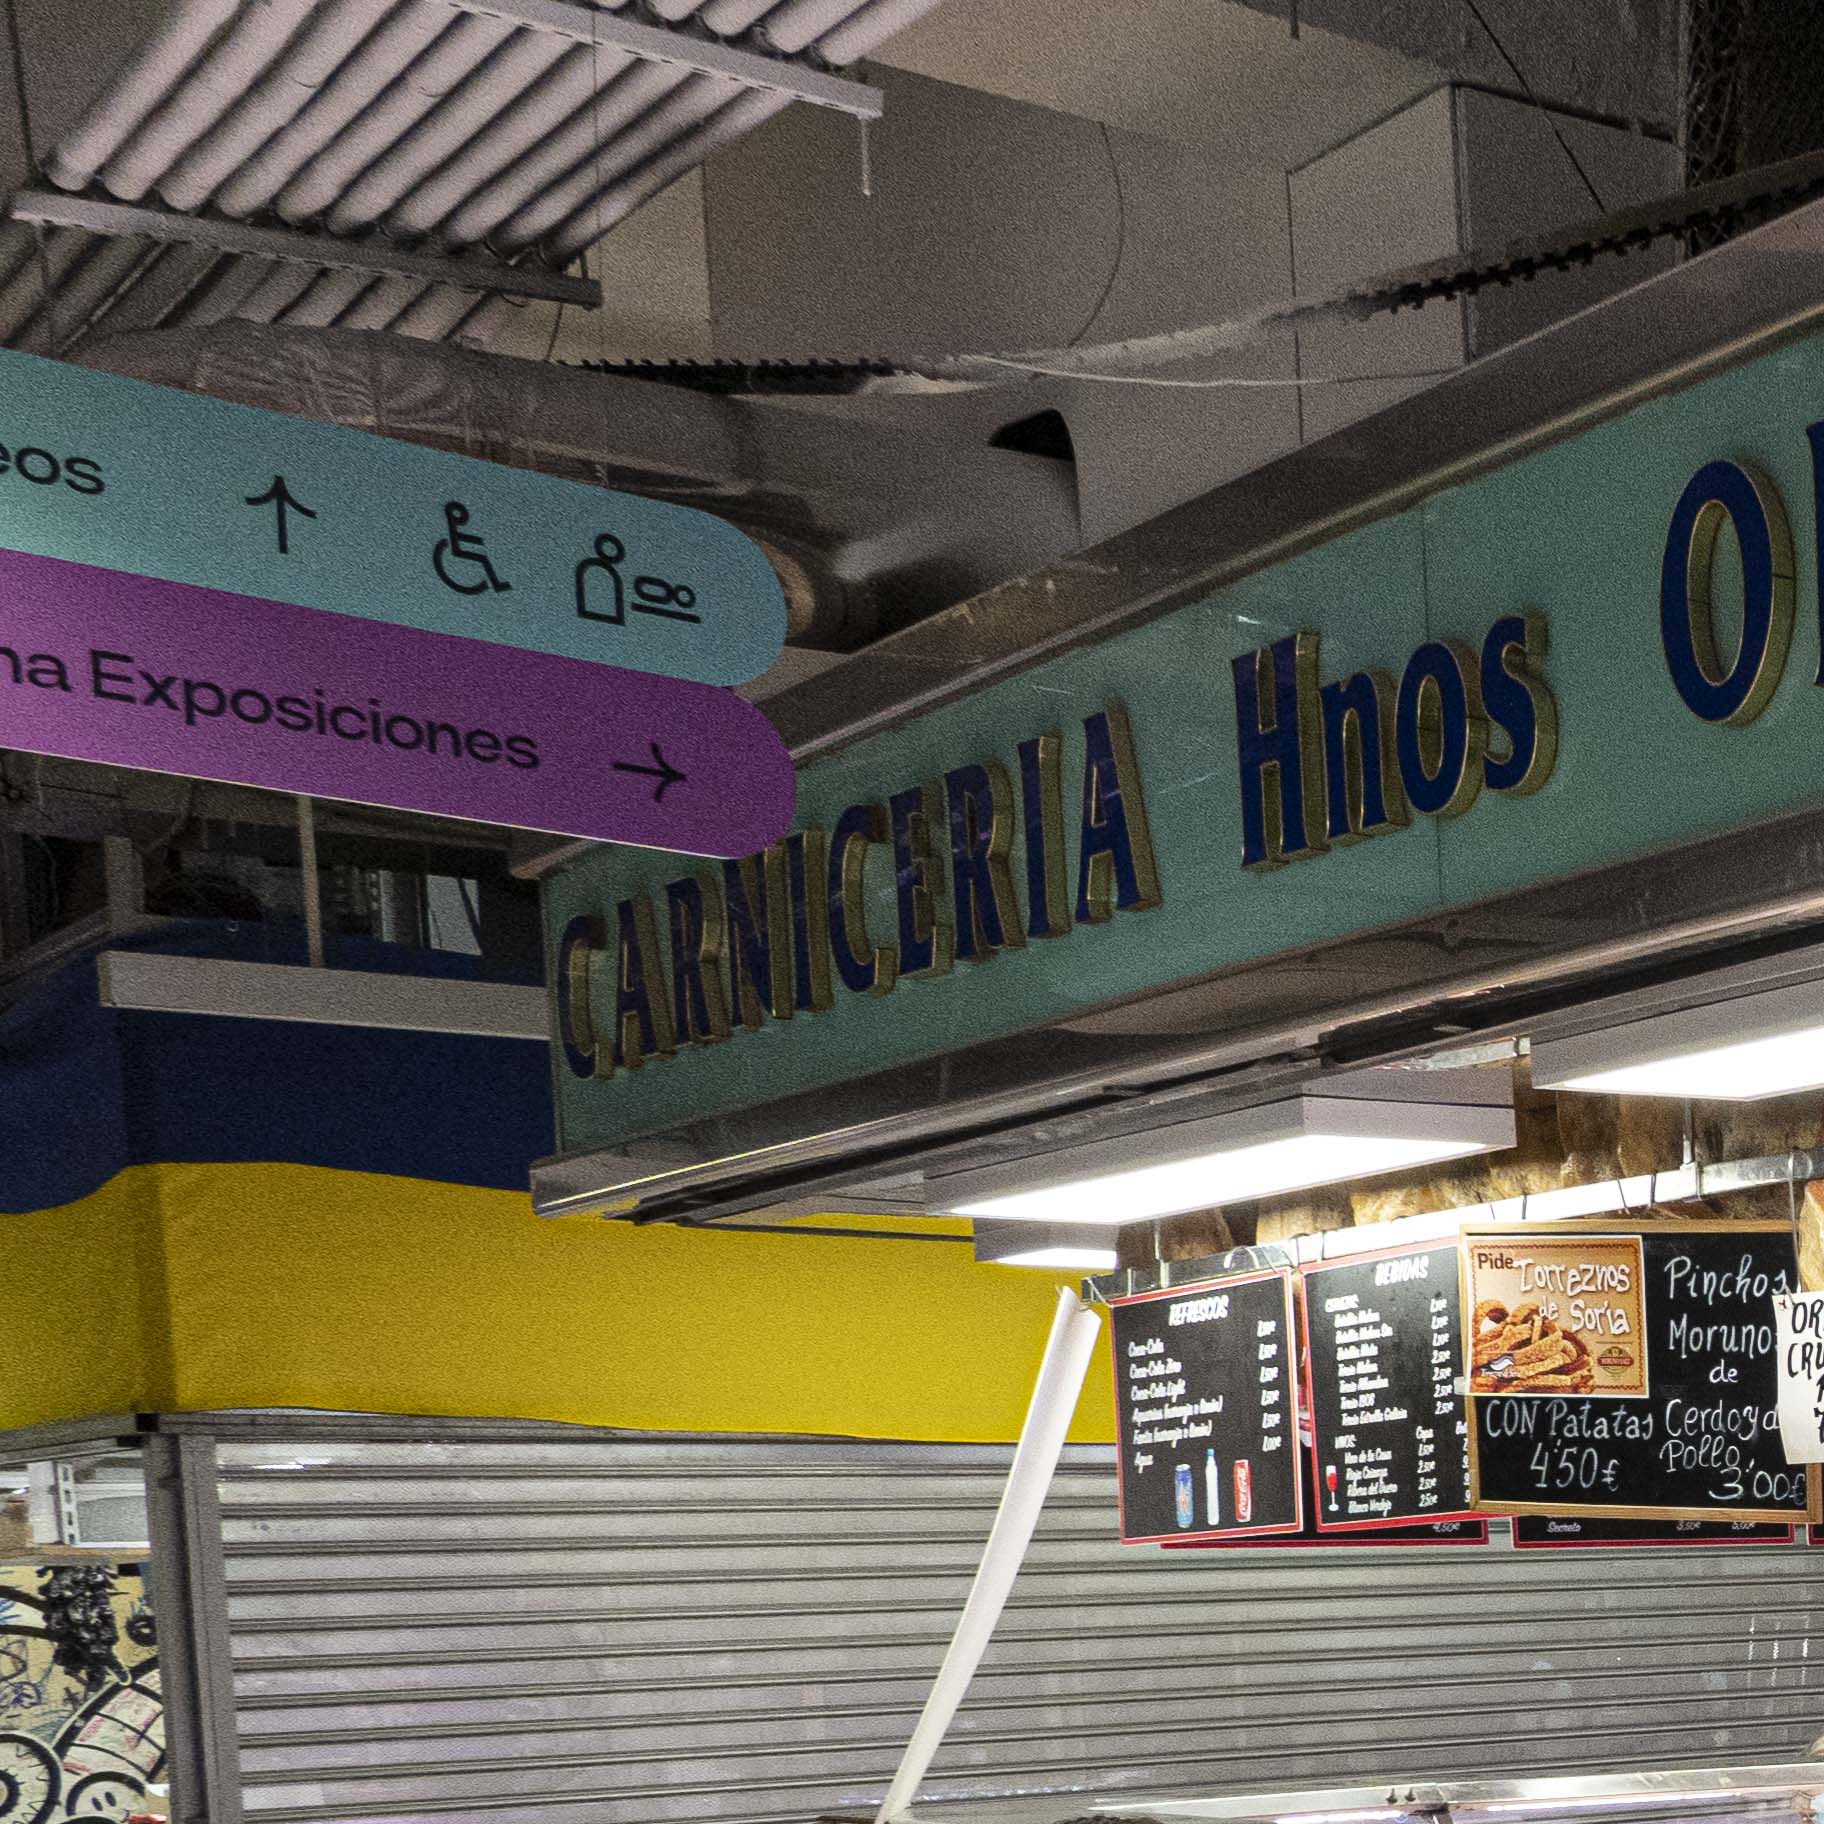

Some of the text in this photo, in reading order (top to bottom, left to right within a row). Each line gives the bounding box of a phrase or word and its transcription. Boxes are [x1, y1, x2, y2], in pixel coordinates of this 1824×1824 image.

[91, 648, 541, 770] Exposiciones
[558, 615, 1557, 1081] CARNICERIA Hnos
[1477, 1253, 1514, 1270] Pide
[1513, 1257, 1631, 1297] Torreznos
[1664, 1254, 1790, 1305] Pinchos
[1538, 1296, 1631, 1336] de Soria
[1668, 1313, 1779, 1359] Moruno
[1709, 1360, 1739, 1384] de
[1486, 1399, 1653, 1440] CON Patatas
[1659, 1434, 1741, 1473] Pollo
